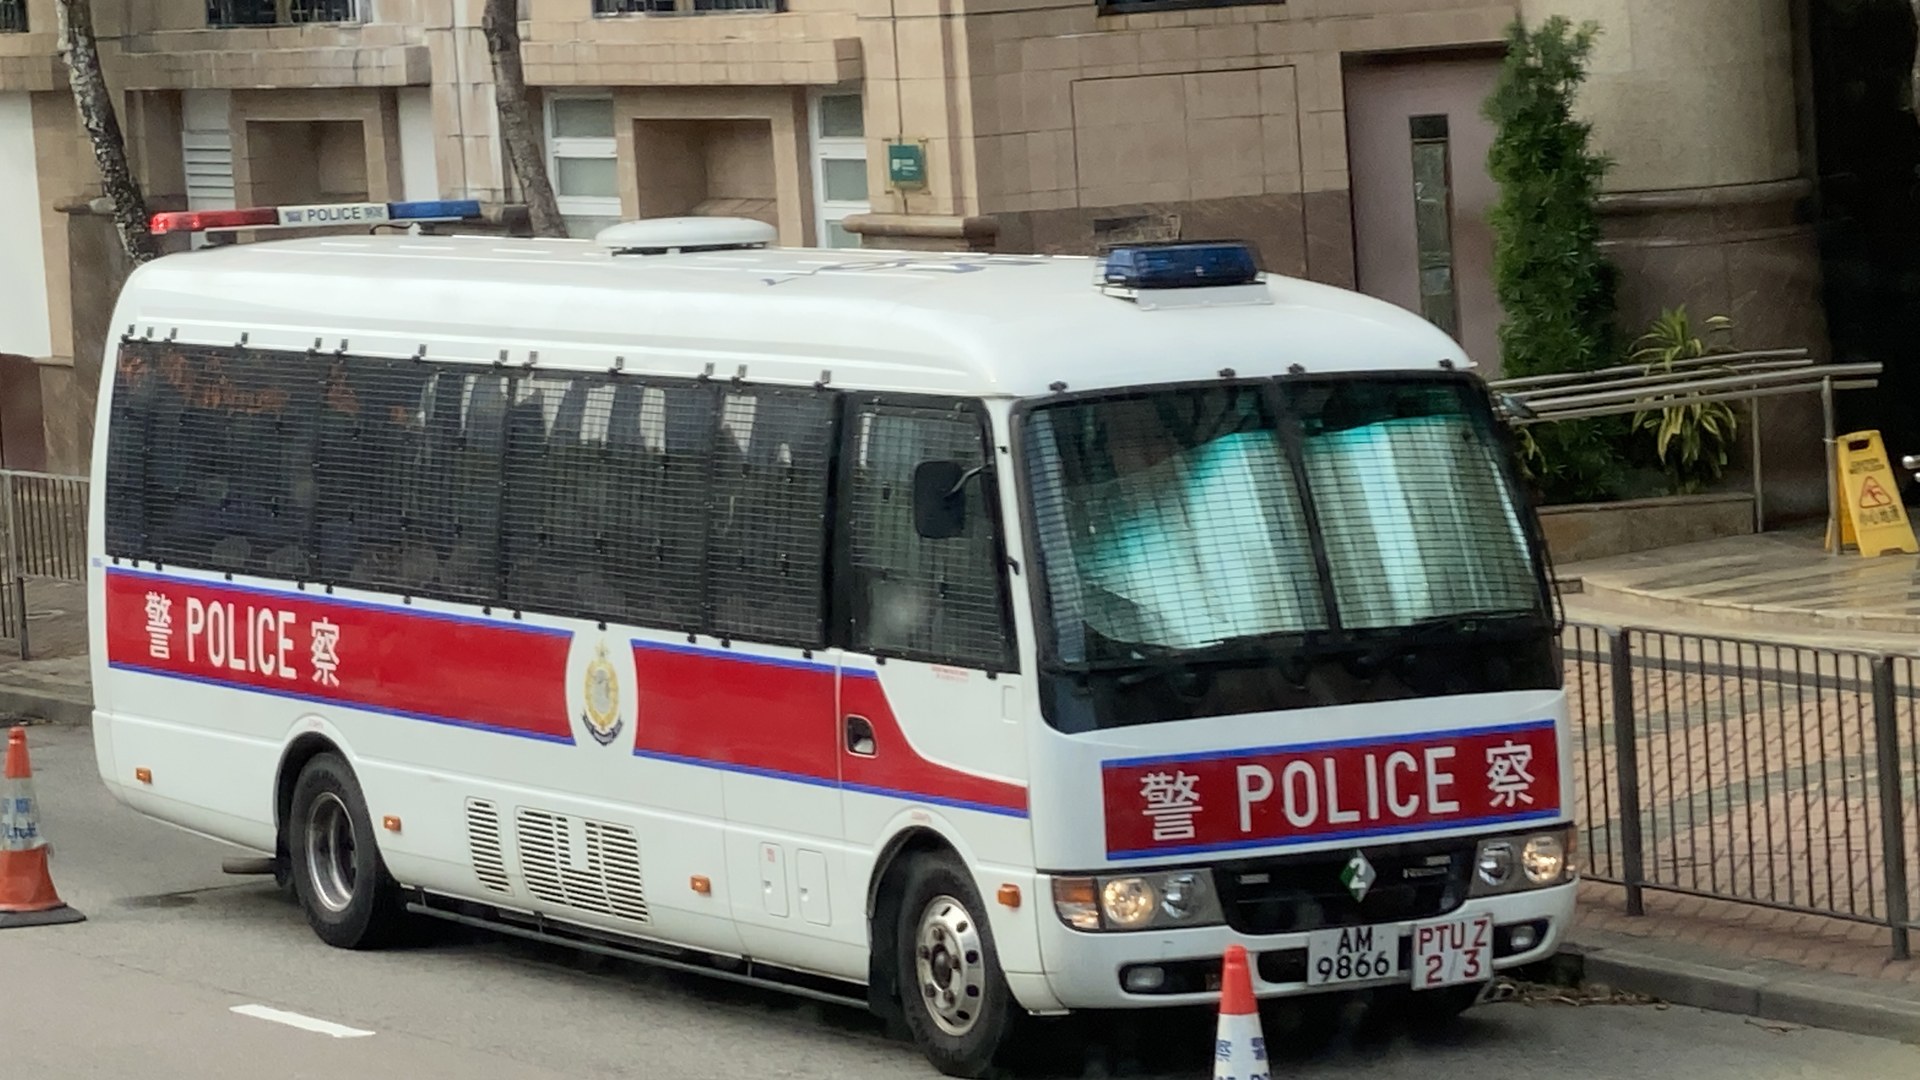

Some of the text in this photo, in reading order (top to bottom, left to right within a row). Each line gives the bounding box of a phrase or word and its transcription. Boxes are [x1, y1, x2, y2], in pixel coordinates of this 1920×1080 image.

[307, 207, 362, 221] POLICE
[145, 591, 340, 687] 警 POLICE 察
[1139, 740, 1534, 842] 警 POLICE 察
[1349, 858, 1366, 889] 2
[1337, 926, 1373, 954] AM
[1317, 951, 1390, 982] 9866
